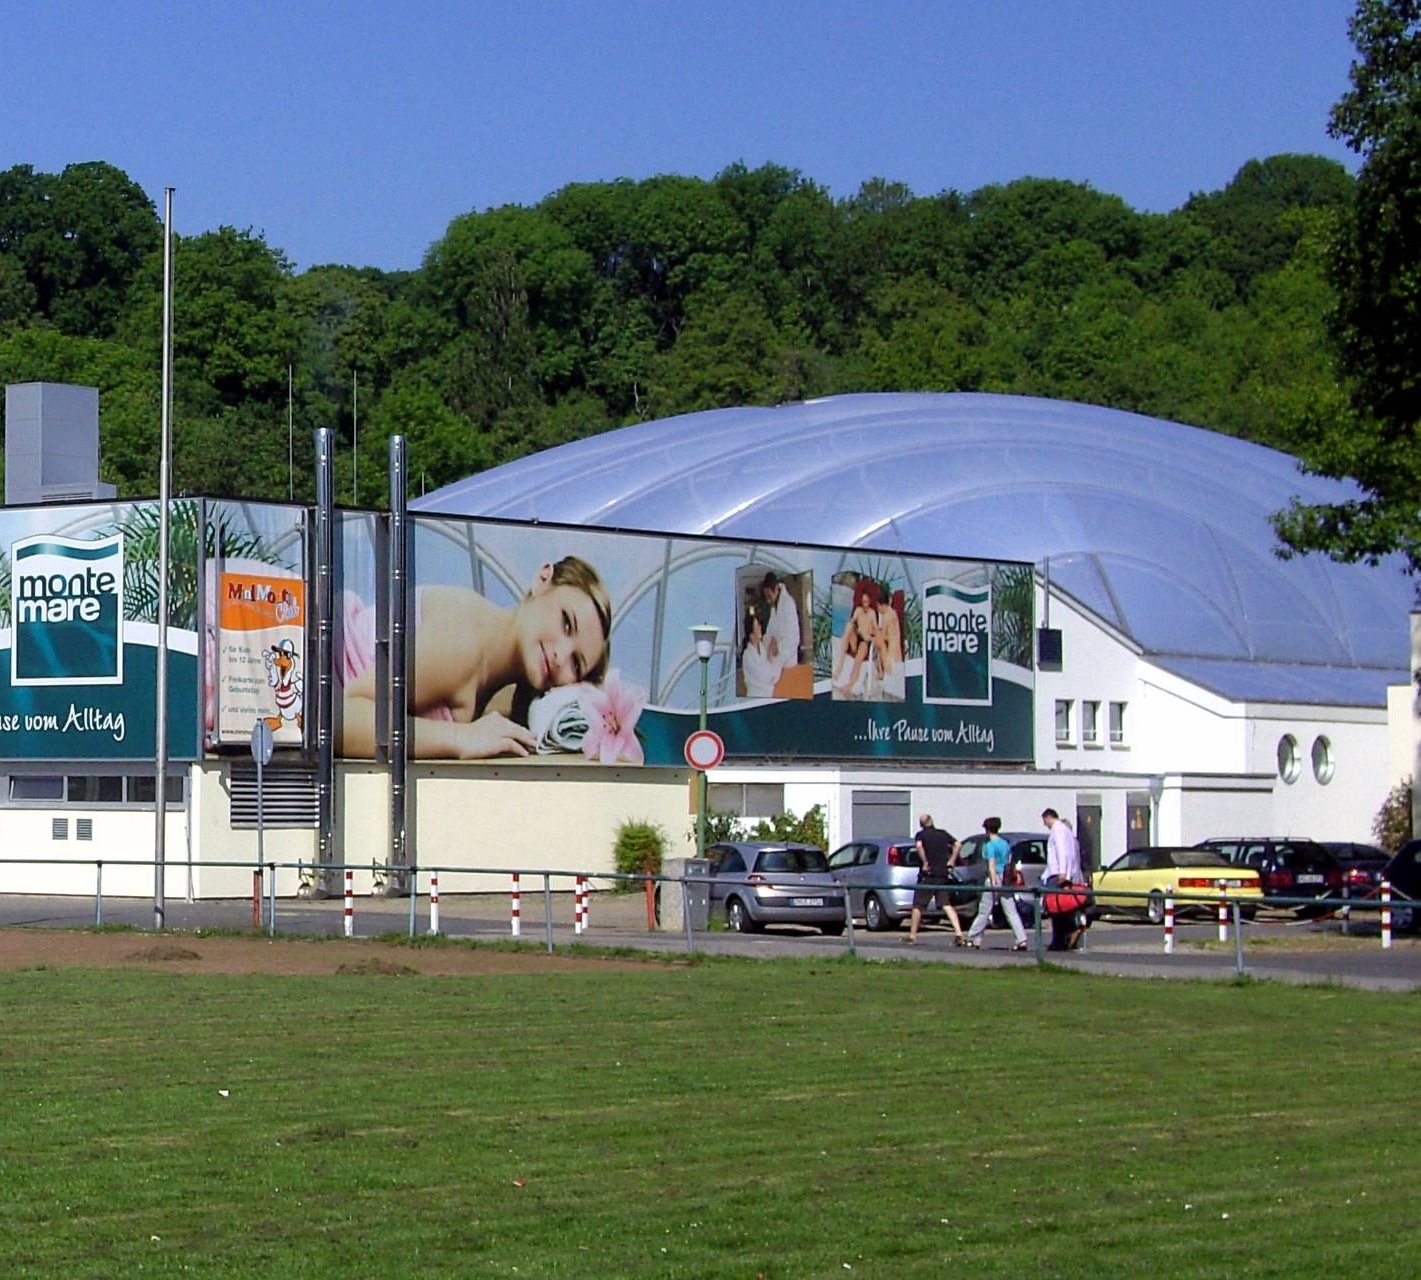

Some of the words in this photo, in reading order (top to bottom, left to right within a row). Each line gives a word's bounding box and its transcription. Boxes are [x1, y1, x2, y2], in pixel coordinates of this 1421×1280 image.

[19, 567, 116, 597] monte
[18, 597, 101, 623] mare
[928, 609, 987, 632] monte
[927, 631, 979, 654] mare
[25, 713, 58, 732] vom
[62, 704, 125, 741] Alltag
[893, 719, 929, 742] Pause
[932, 725, 954, 742] vom
[955, 720, 994, 752] Alltag
